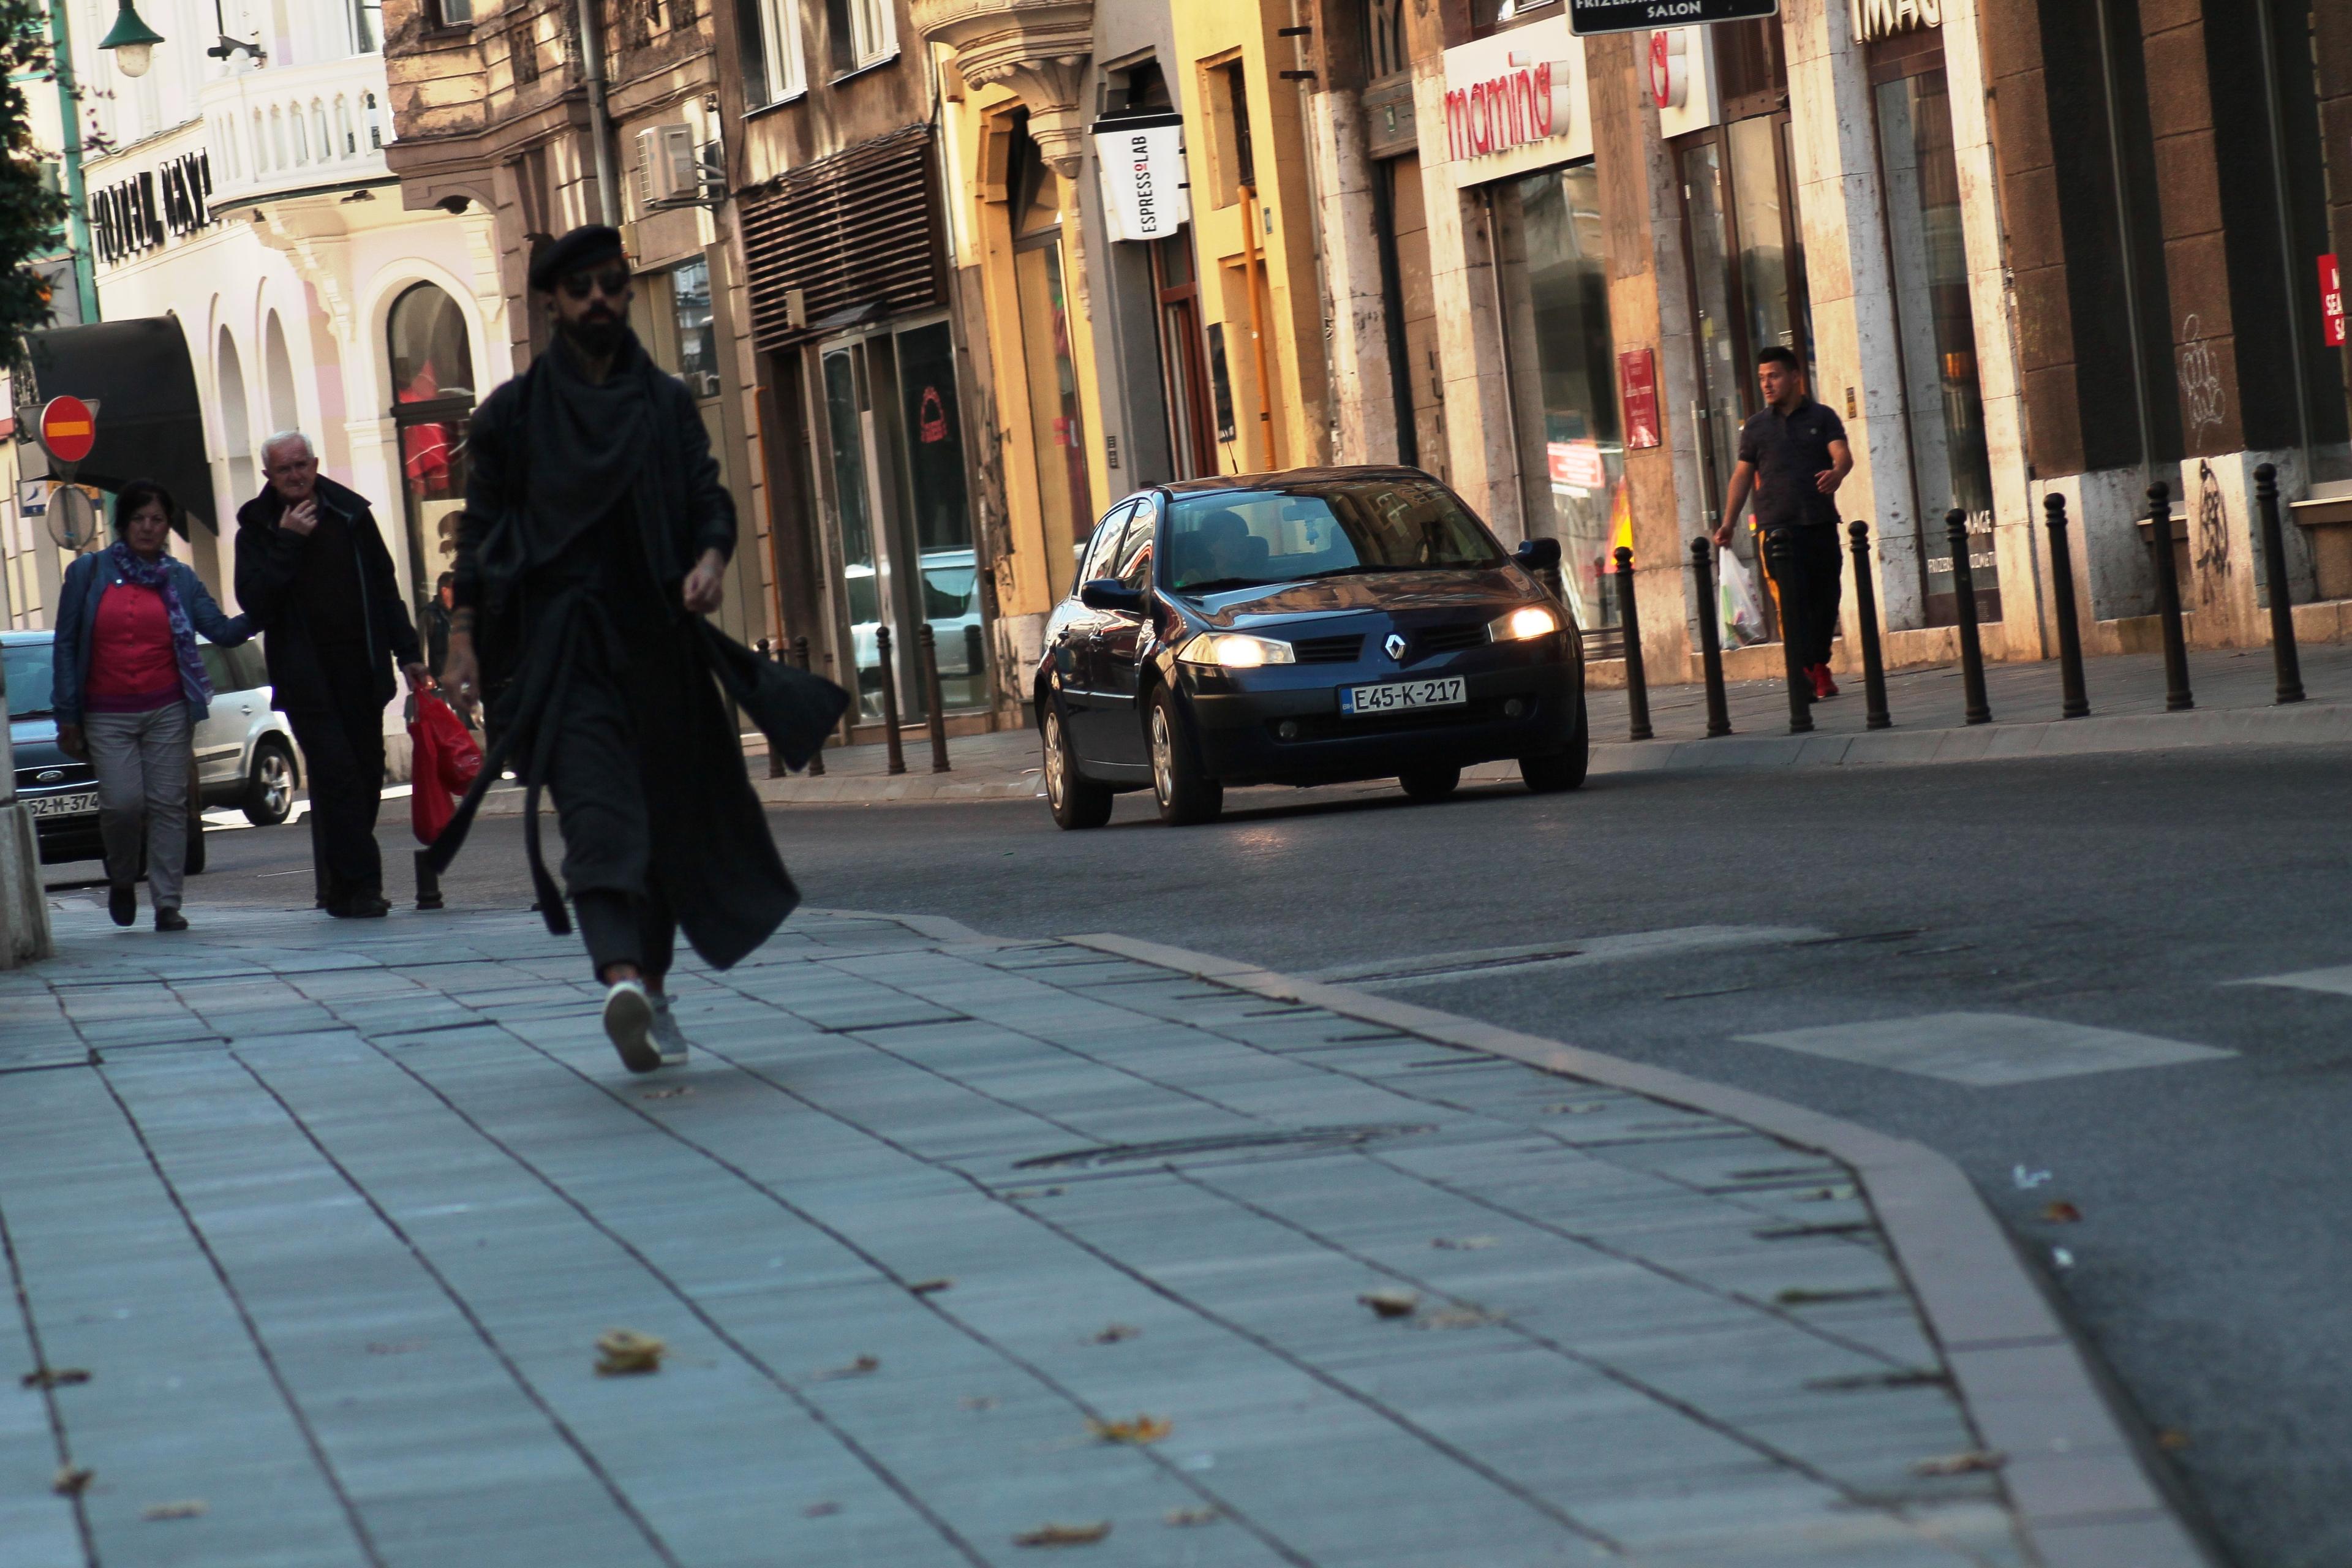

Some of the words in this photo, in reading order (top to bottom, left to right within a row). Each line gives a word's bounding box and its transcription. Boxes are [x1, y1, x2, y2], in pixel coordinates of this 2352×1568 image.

[1648, 1, 1701, 18] SALON
[88, 171, 162, 263] HOTEL
[1354, 680, 1461, 710] E45-K-217
